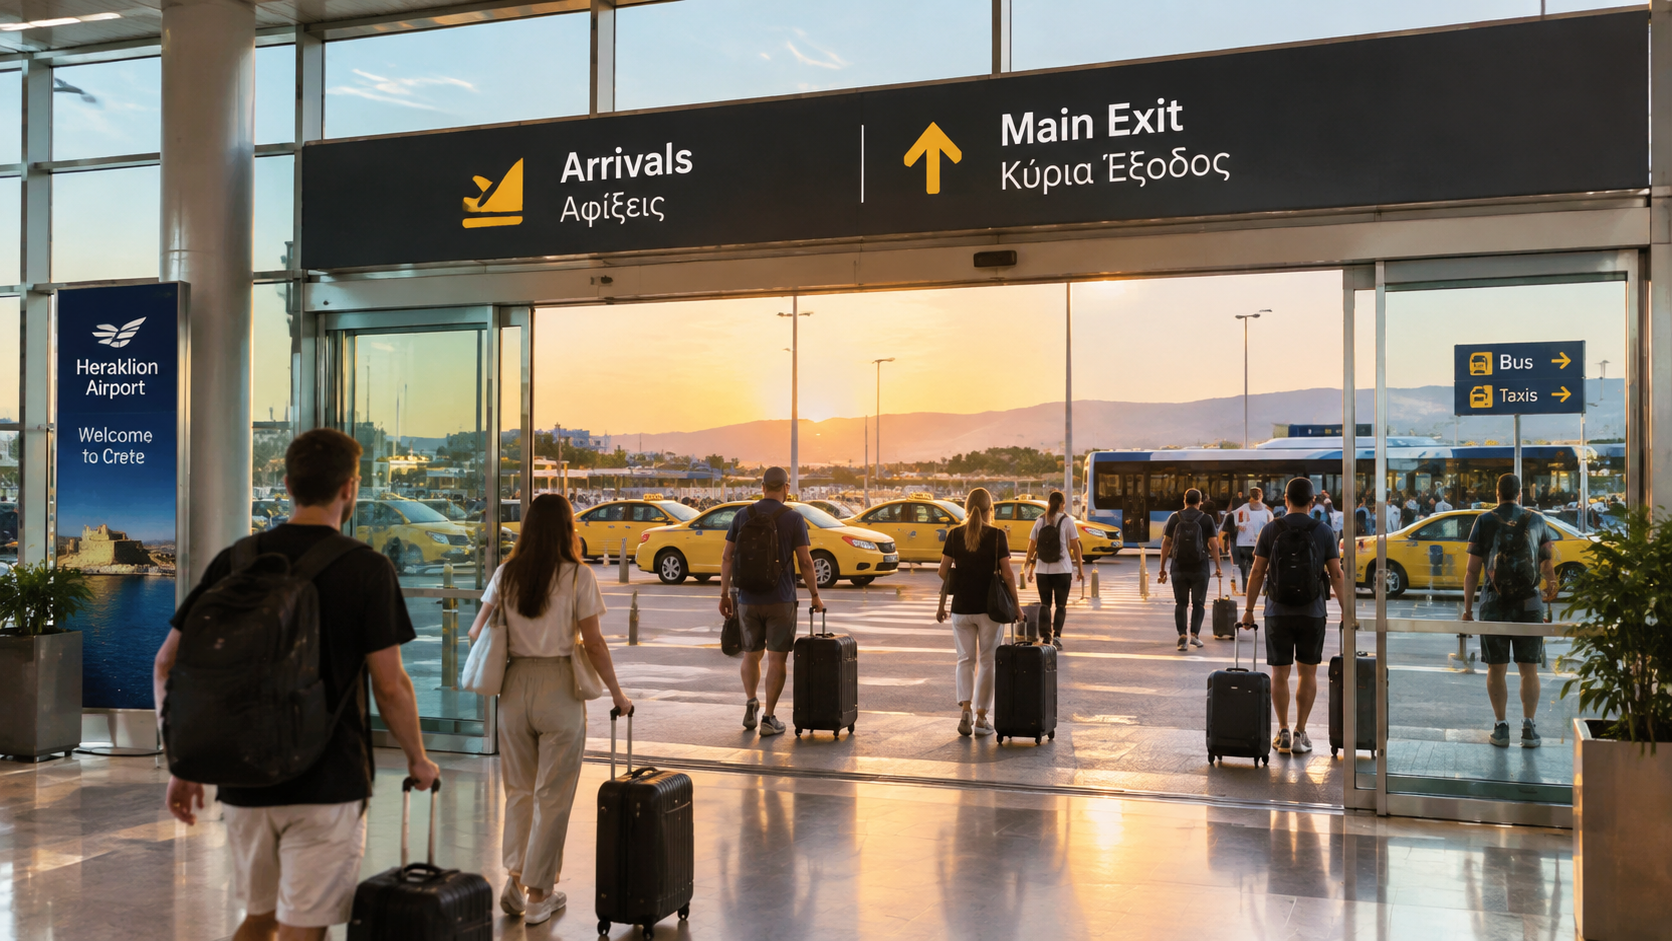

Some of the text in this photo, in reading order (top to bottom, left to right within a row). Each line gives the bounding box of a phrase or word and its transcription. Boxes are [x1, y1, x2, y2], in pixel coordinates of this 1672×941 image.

[1001, 97, 1184, 147] Main Exit
[560, 142, 693, 183] Arrivals
[1002, 146, 1231, 195] Κύρια Έξοδος
[560, 191, 665, 228] Αφίξεις
[76, 358, 159, 376] Heraklion
[1499, 354, 1534, 370] Bus
[85, 379, 146, 400] Airport
[1499, 387, 1538, 403] Taxis
[78, 426, 153, 444] Welcome
[82, 447, 145, 465] to Crete
